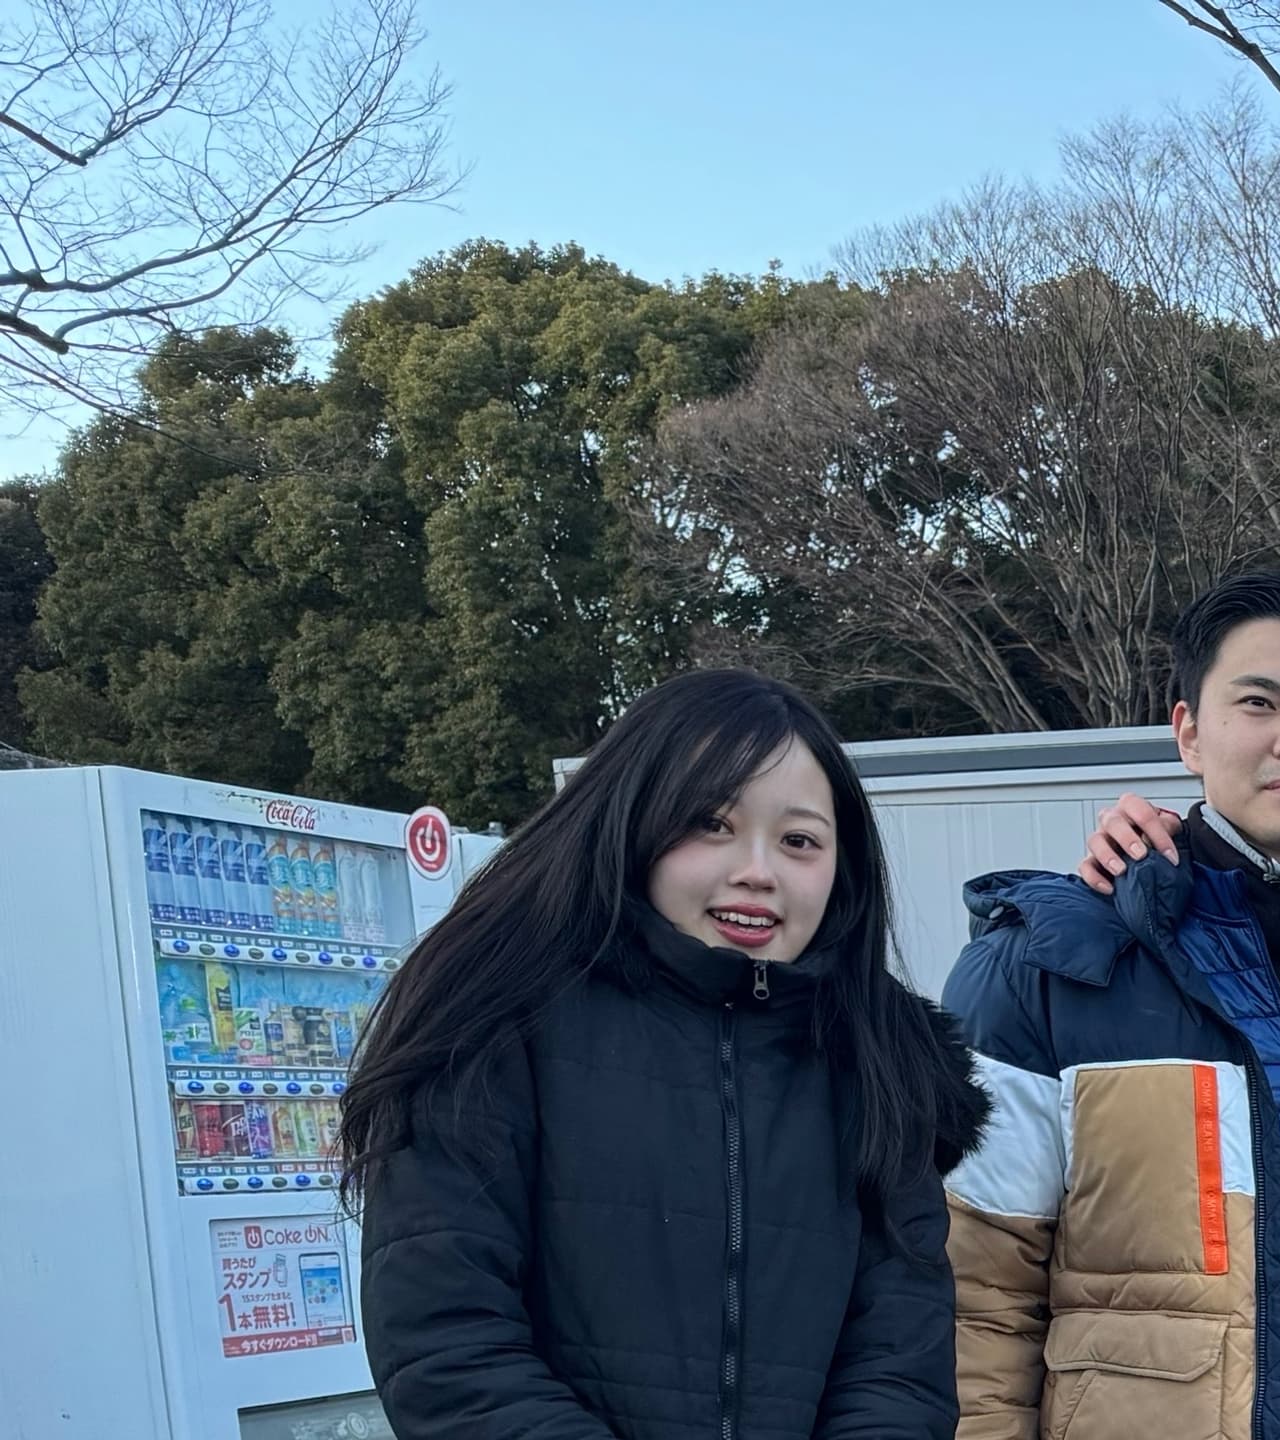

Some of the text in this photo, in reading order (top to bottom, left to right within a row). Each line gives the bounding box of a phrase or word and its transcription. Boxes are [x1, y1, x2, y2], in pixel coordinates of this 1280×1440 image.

[264, 1228, 303, 1246] Coke
[223, 1268, 272, 1291] スタンプ
